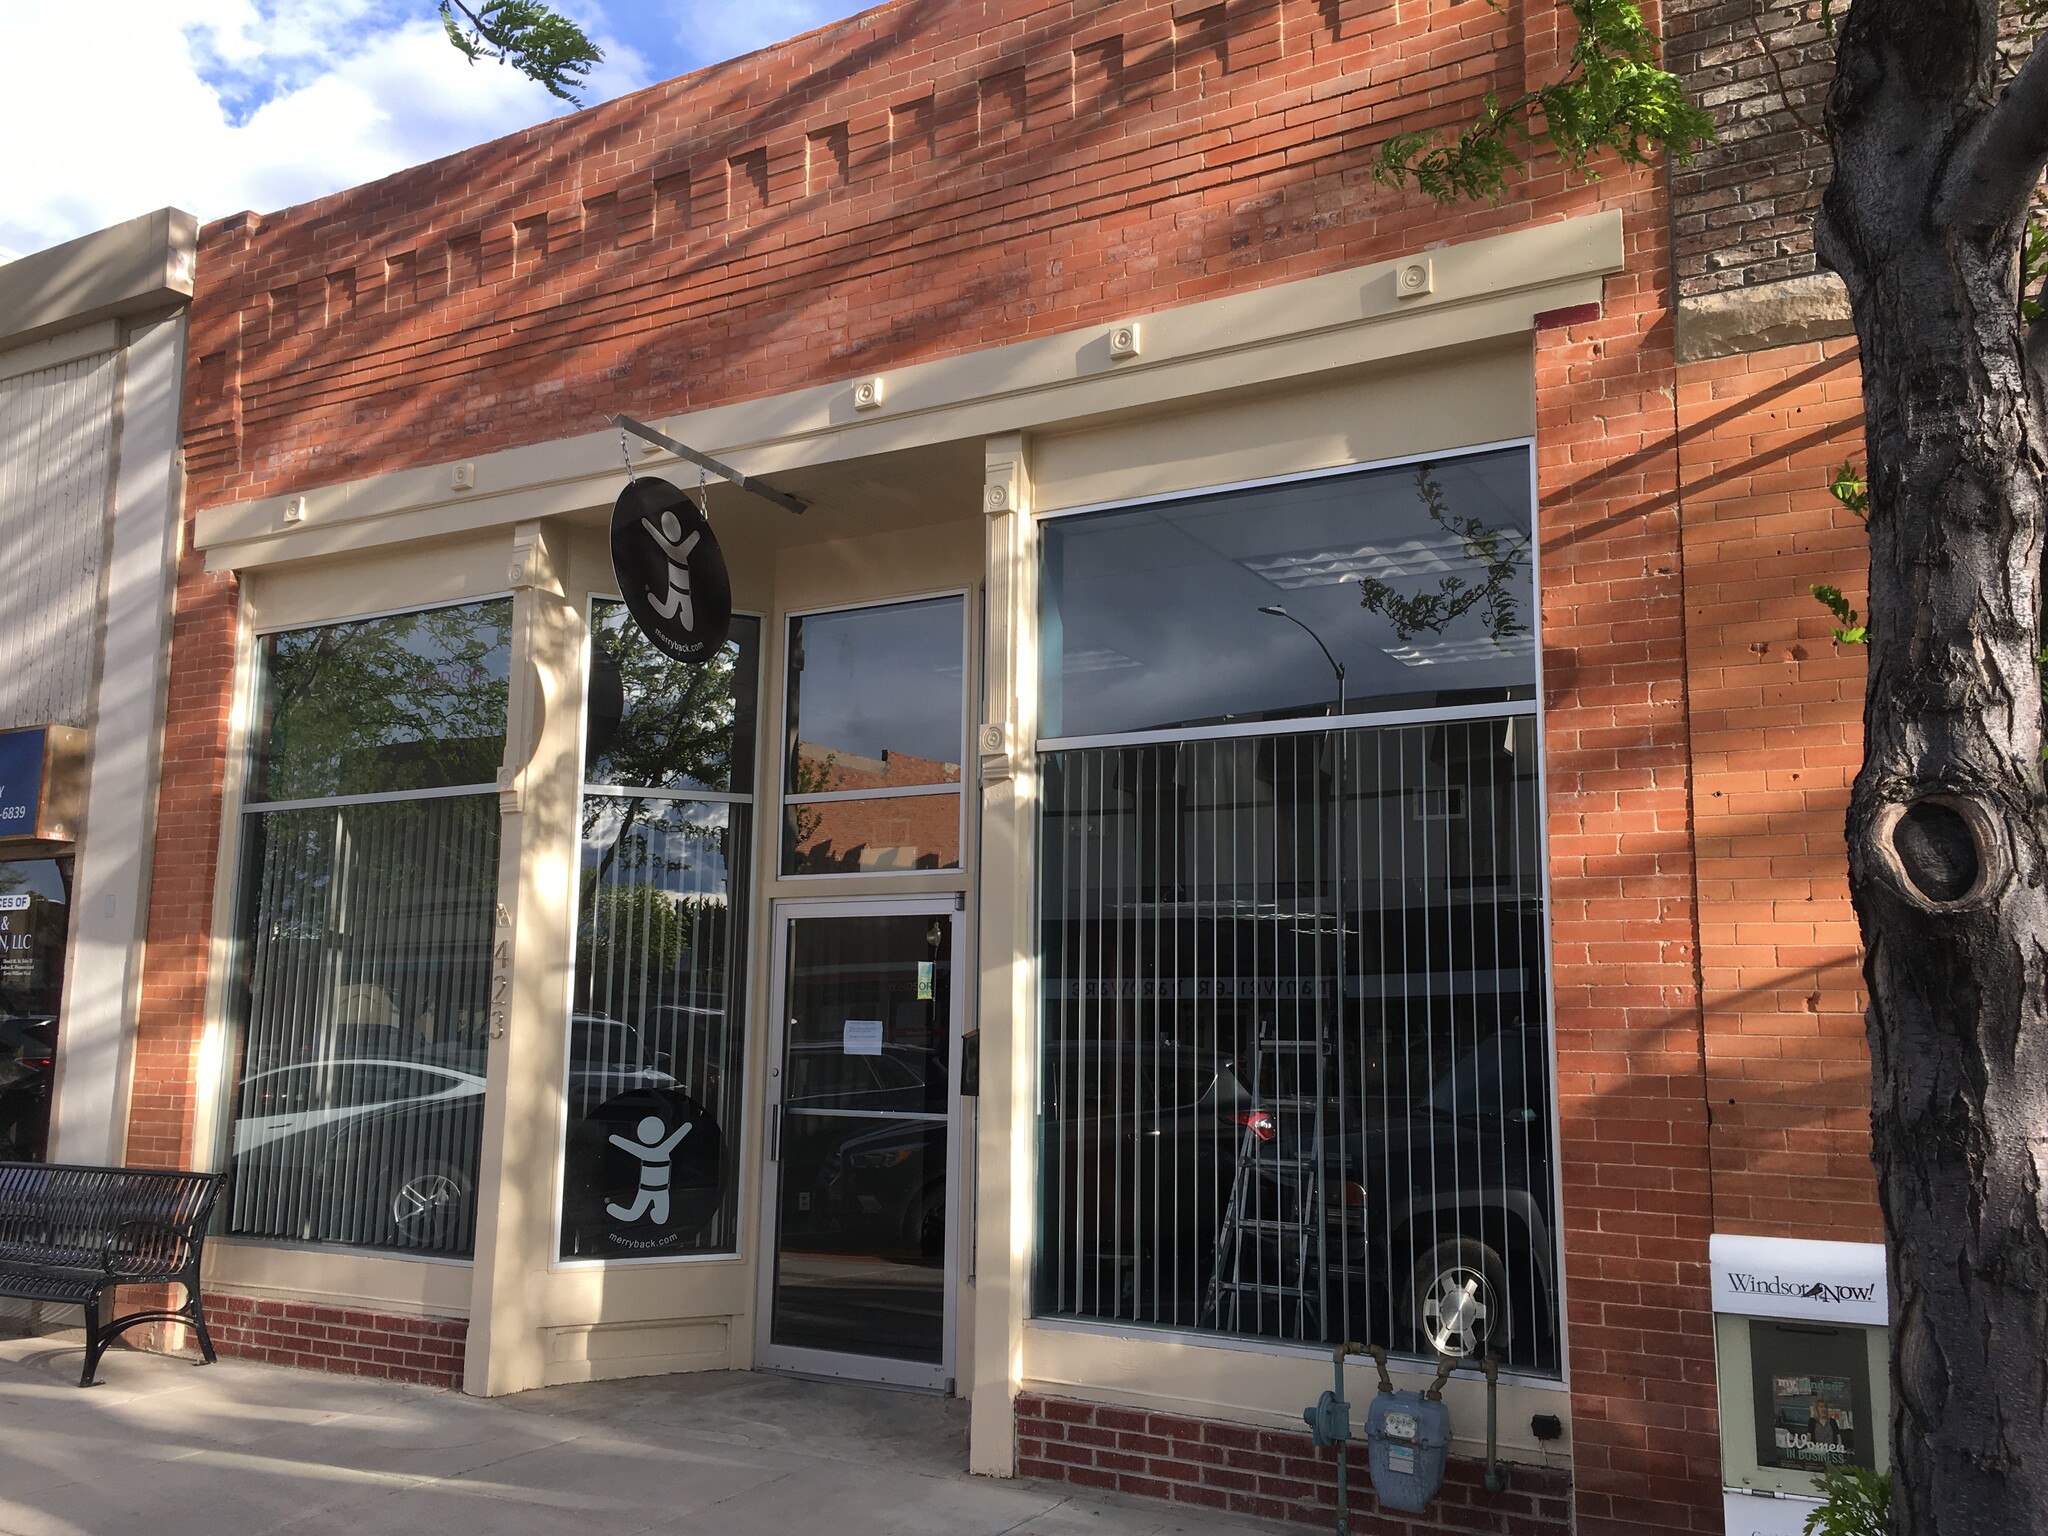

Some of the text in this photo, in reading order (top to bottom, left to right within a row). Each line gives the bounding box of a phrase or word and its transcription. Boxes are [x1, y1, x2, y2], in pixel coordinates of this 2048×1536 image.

[654, 627, 705, 654] merryback.com
[15, 896, 28, 908] OF
[1, 915, 10, 931] &
[12, 934, 32, 950] LLC
[489, 939, 510, 1041] 423
[608, 1232, 678, 1249] merryback.com
[1727, 1272, 1810, 1297] Windsor
[1786, 1431, 1849, 1454] Women
